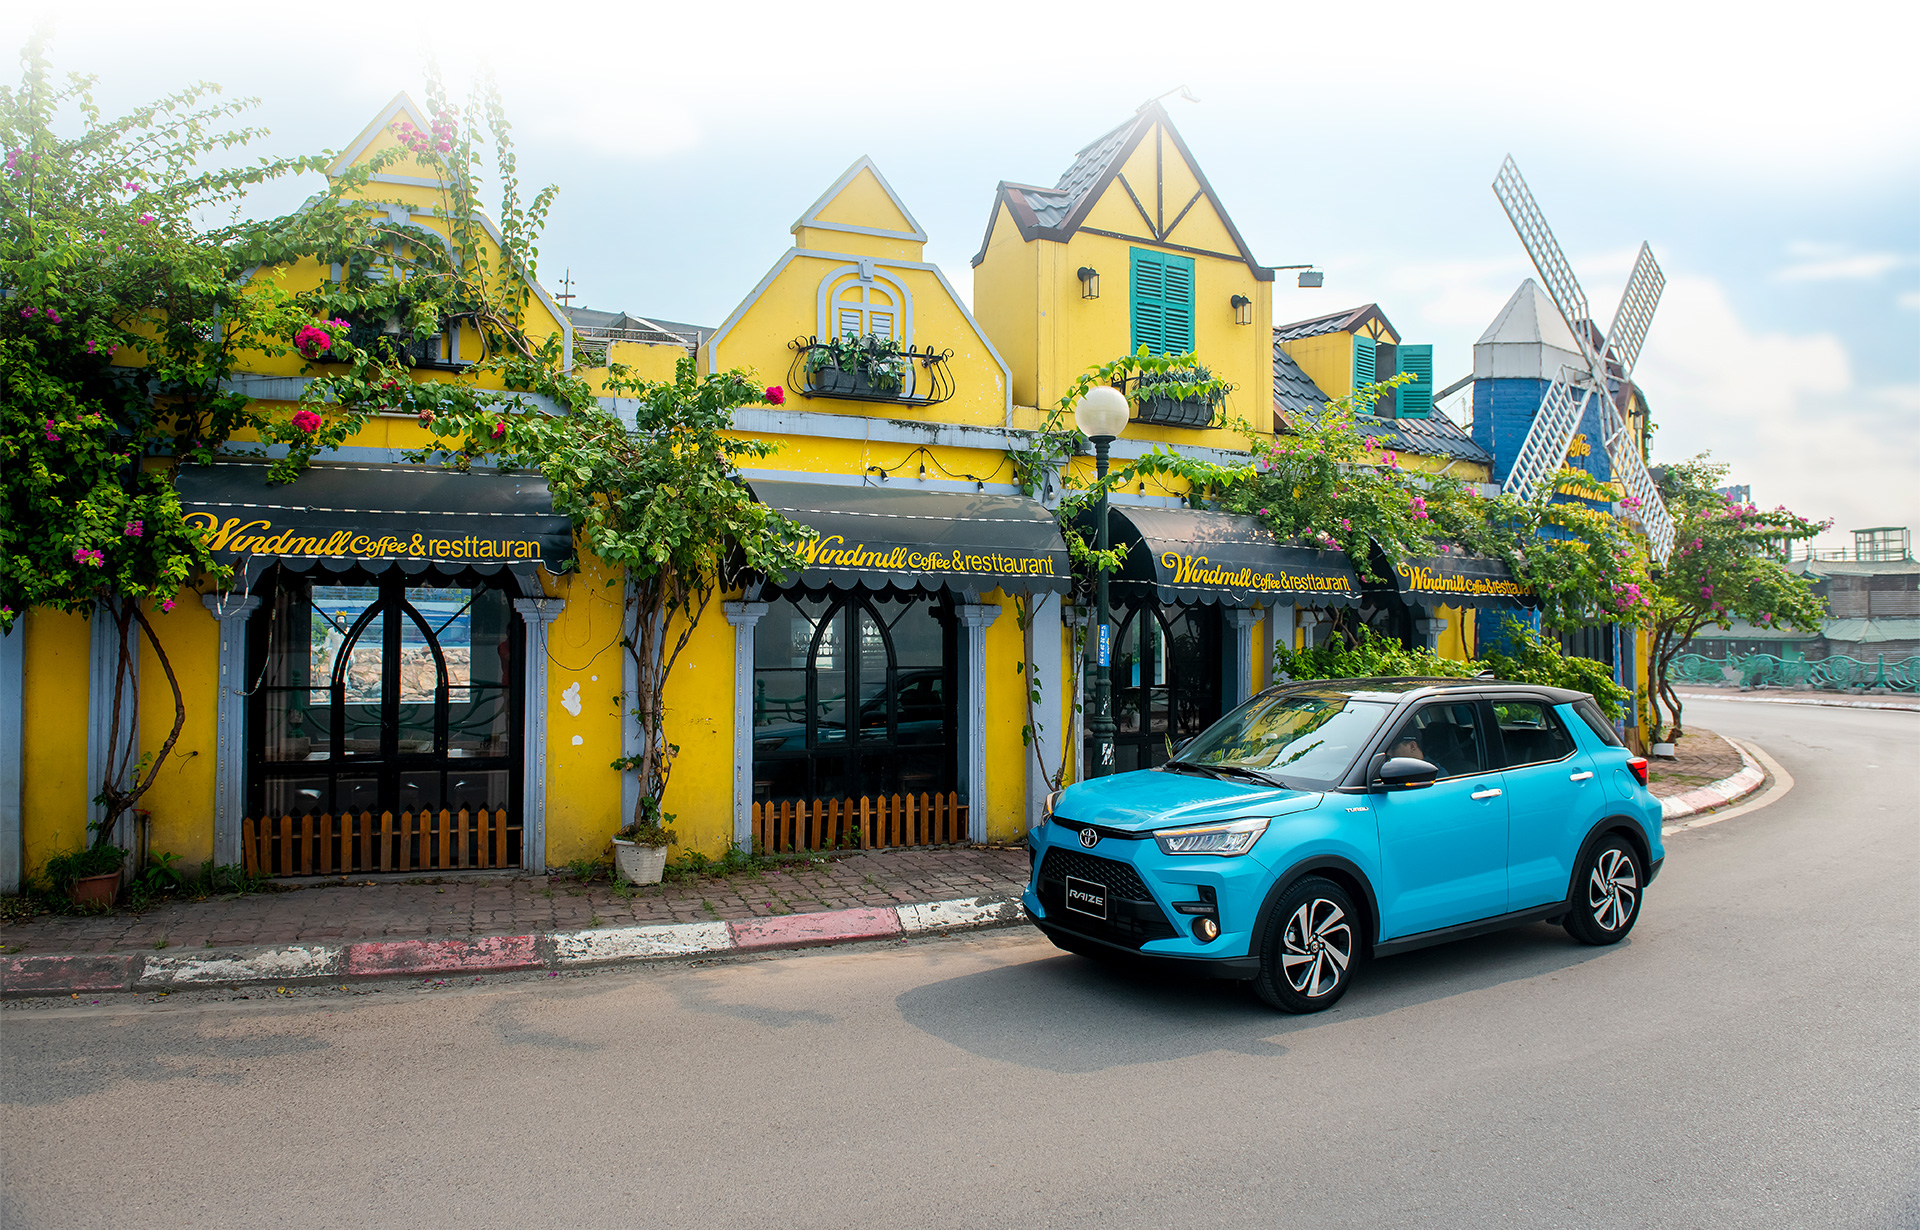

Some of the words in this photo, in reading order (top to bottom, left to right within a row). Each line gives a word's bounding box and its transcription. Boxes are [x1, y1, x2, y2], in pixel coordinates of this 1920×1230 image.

[180, 511, 352, 556] Windmill
[350, 535, 407, 558] Coffee
[787, 534, 907, 569] Windmill
[907, 551, 951, 571] Coffee
[1161, 551, 1252, 588] Windmill
[1252, 572, 1281, 591] Coffee
[1397, 562, 1466, 592] Windmill
[1465, 578, 1487, 595] Coffee
[1069, 888, 1104, 906] RAIZE
